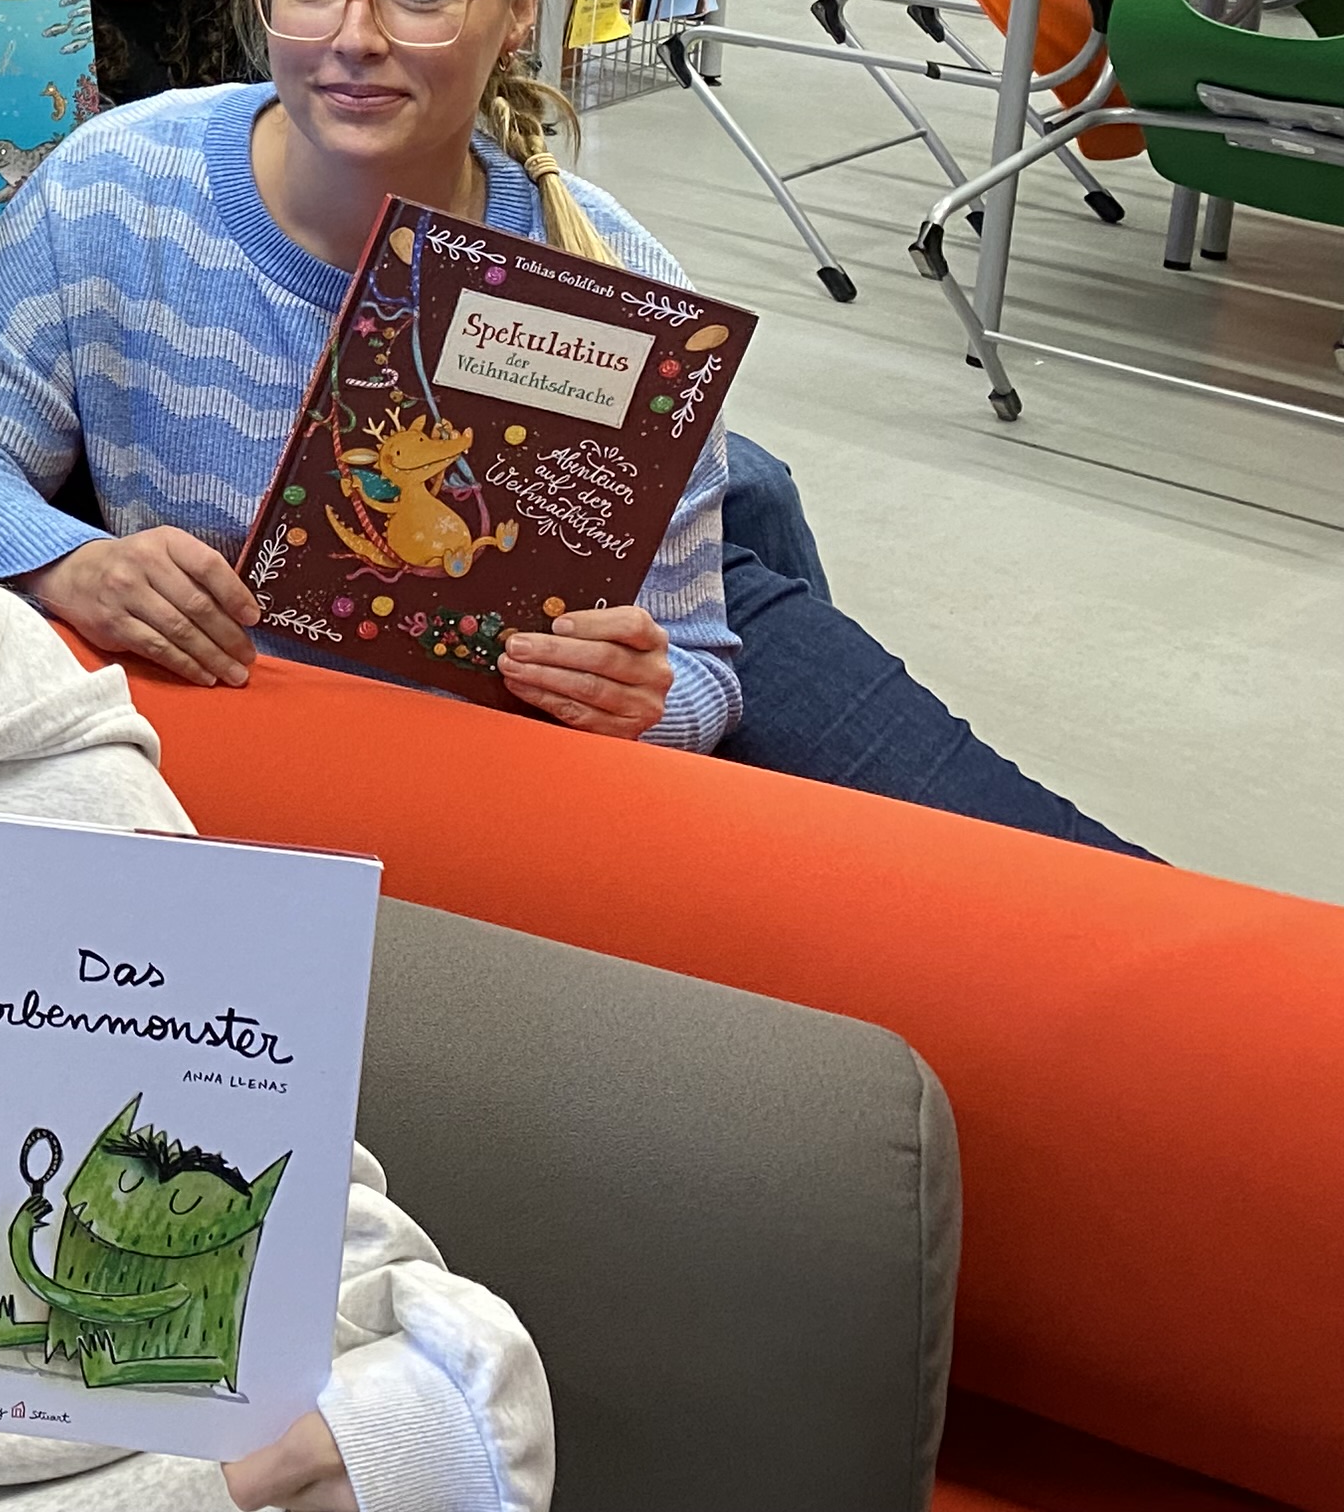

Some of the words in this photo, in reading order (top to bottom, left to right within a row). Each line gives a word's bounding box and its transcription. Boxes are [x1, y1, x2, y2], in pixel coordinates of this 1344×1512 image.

[513, 254, 557, 282] Tobias
[557, 269, 616, 300] Goldfarb
[461, 311, 631, 374] Spekulatius
[505, 351, 531, 371] der
[456, 353, 616, 409] Weihnachtsdrache
[534, 463, 572, 494] auf
[577, 485, 613, 520] der
[536, 445, 635, 505] Abenteuer
[484, 452, 636, 561] Weihnachtsinsel
[78, 948, 166, 989] Das
[181, 1069, 224, 1087] ANNA
[228, 1074, 289, 1095] LLENAS
[28, 1409, 72, 1425] Stuart
